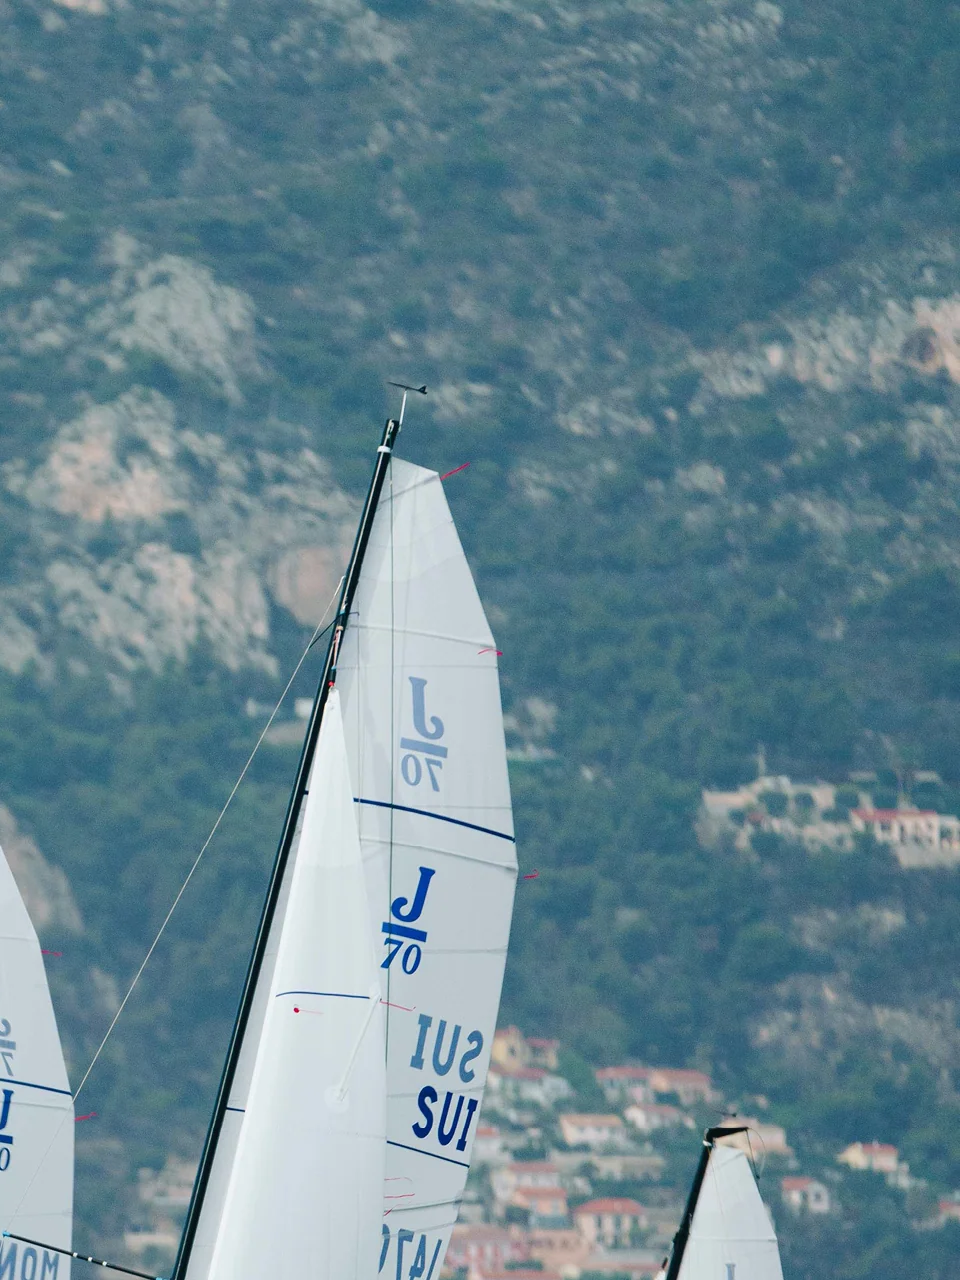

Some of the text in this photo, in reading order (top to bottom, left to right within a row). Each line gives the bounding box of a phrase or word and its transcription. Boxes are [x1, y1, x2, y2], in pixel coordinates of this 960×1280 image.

[390, 866, 436, 923] J
[380, 937, 422, 975] 70
[411, 1085, 478, 1152] SUI
